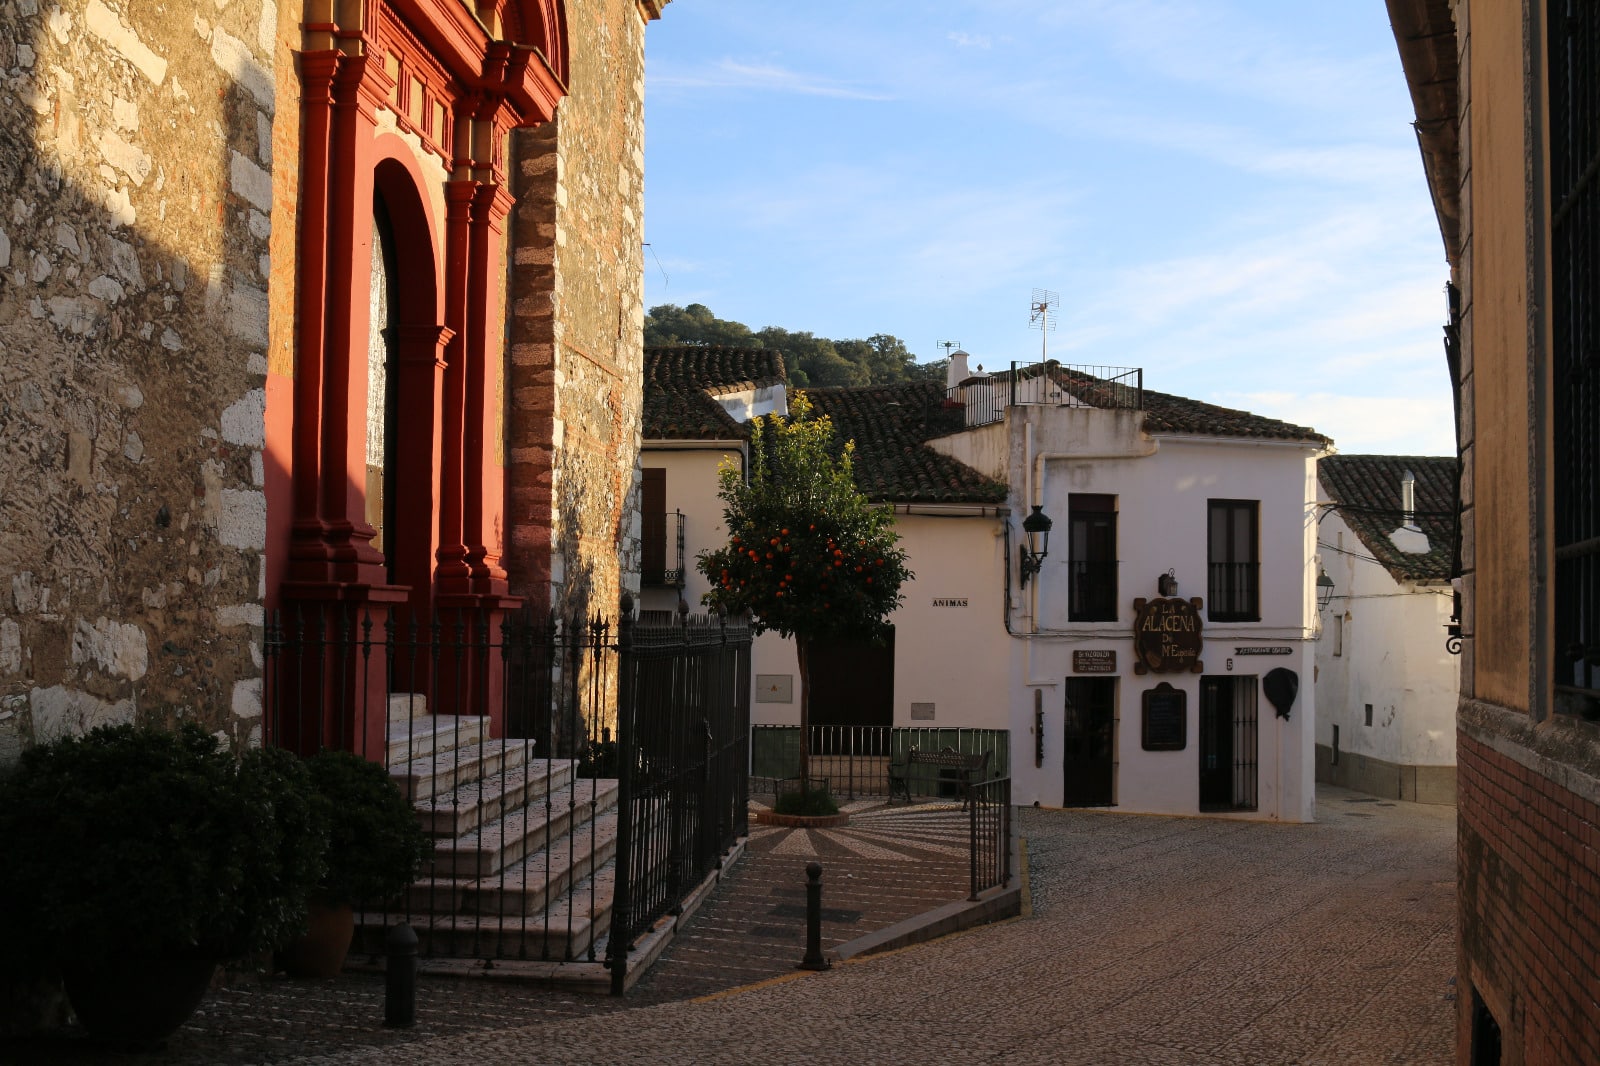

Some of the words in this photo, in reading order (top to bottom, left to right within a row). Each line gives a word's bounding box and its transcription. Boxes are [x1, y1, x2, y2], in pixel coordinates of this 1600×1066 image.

[932, 599, 968, 607] ANIMAS
[1162, 604, 1176, 614] LA
[1142, 615, 1195, 632] ALACENA
